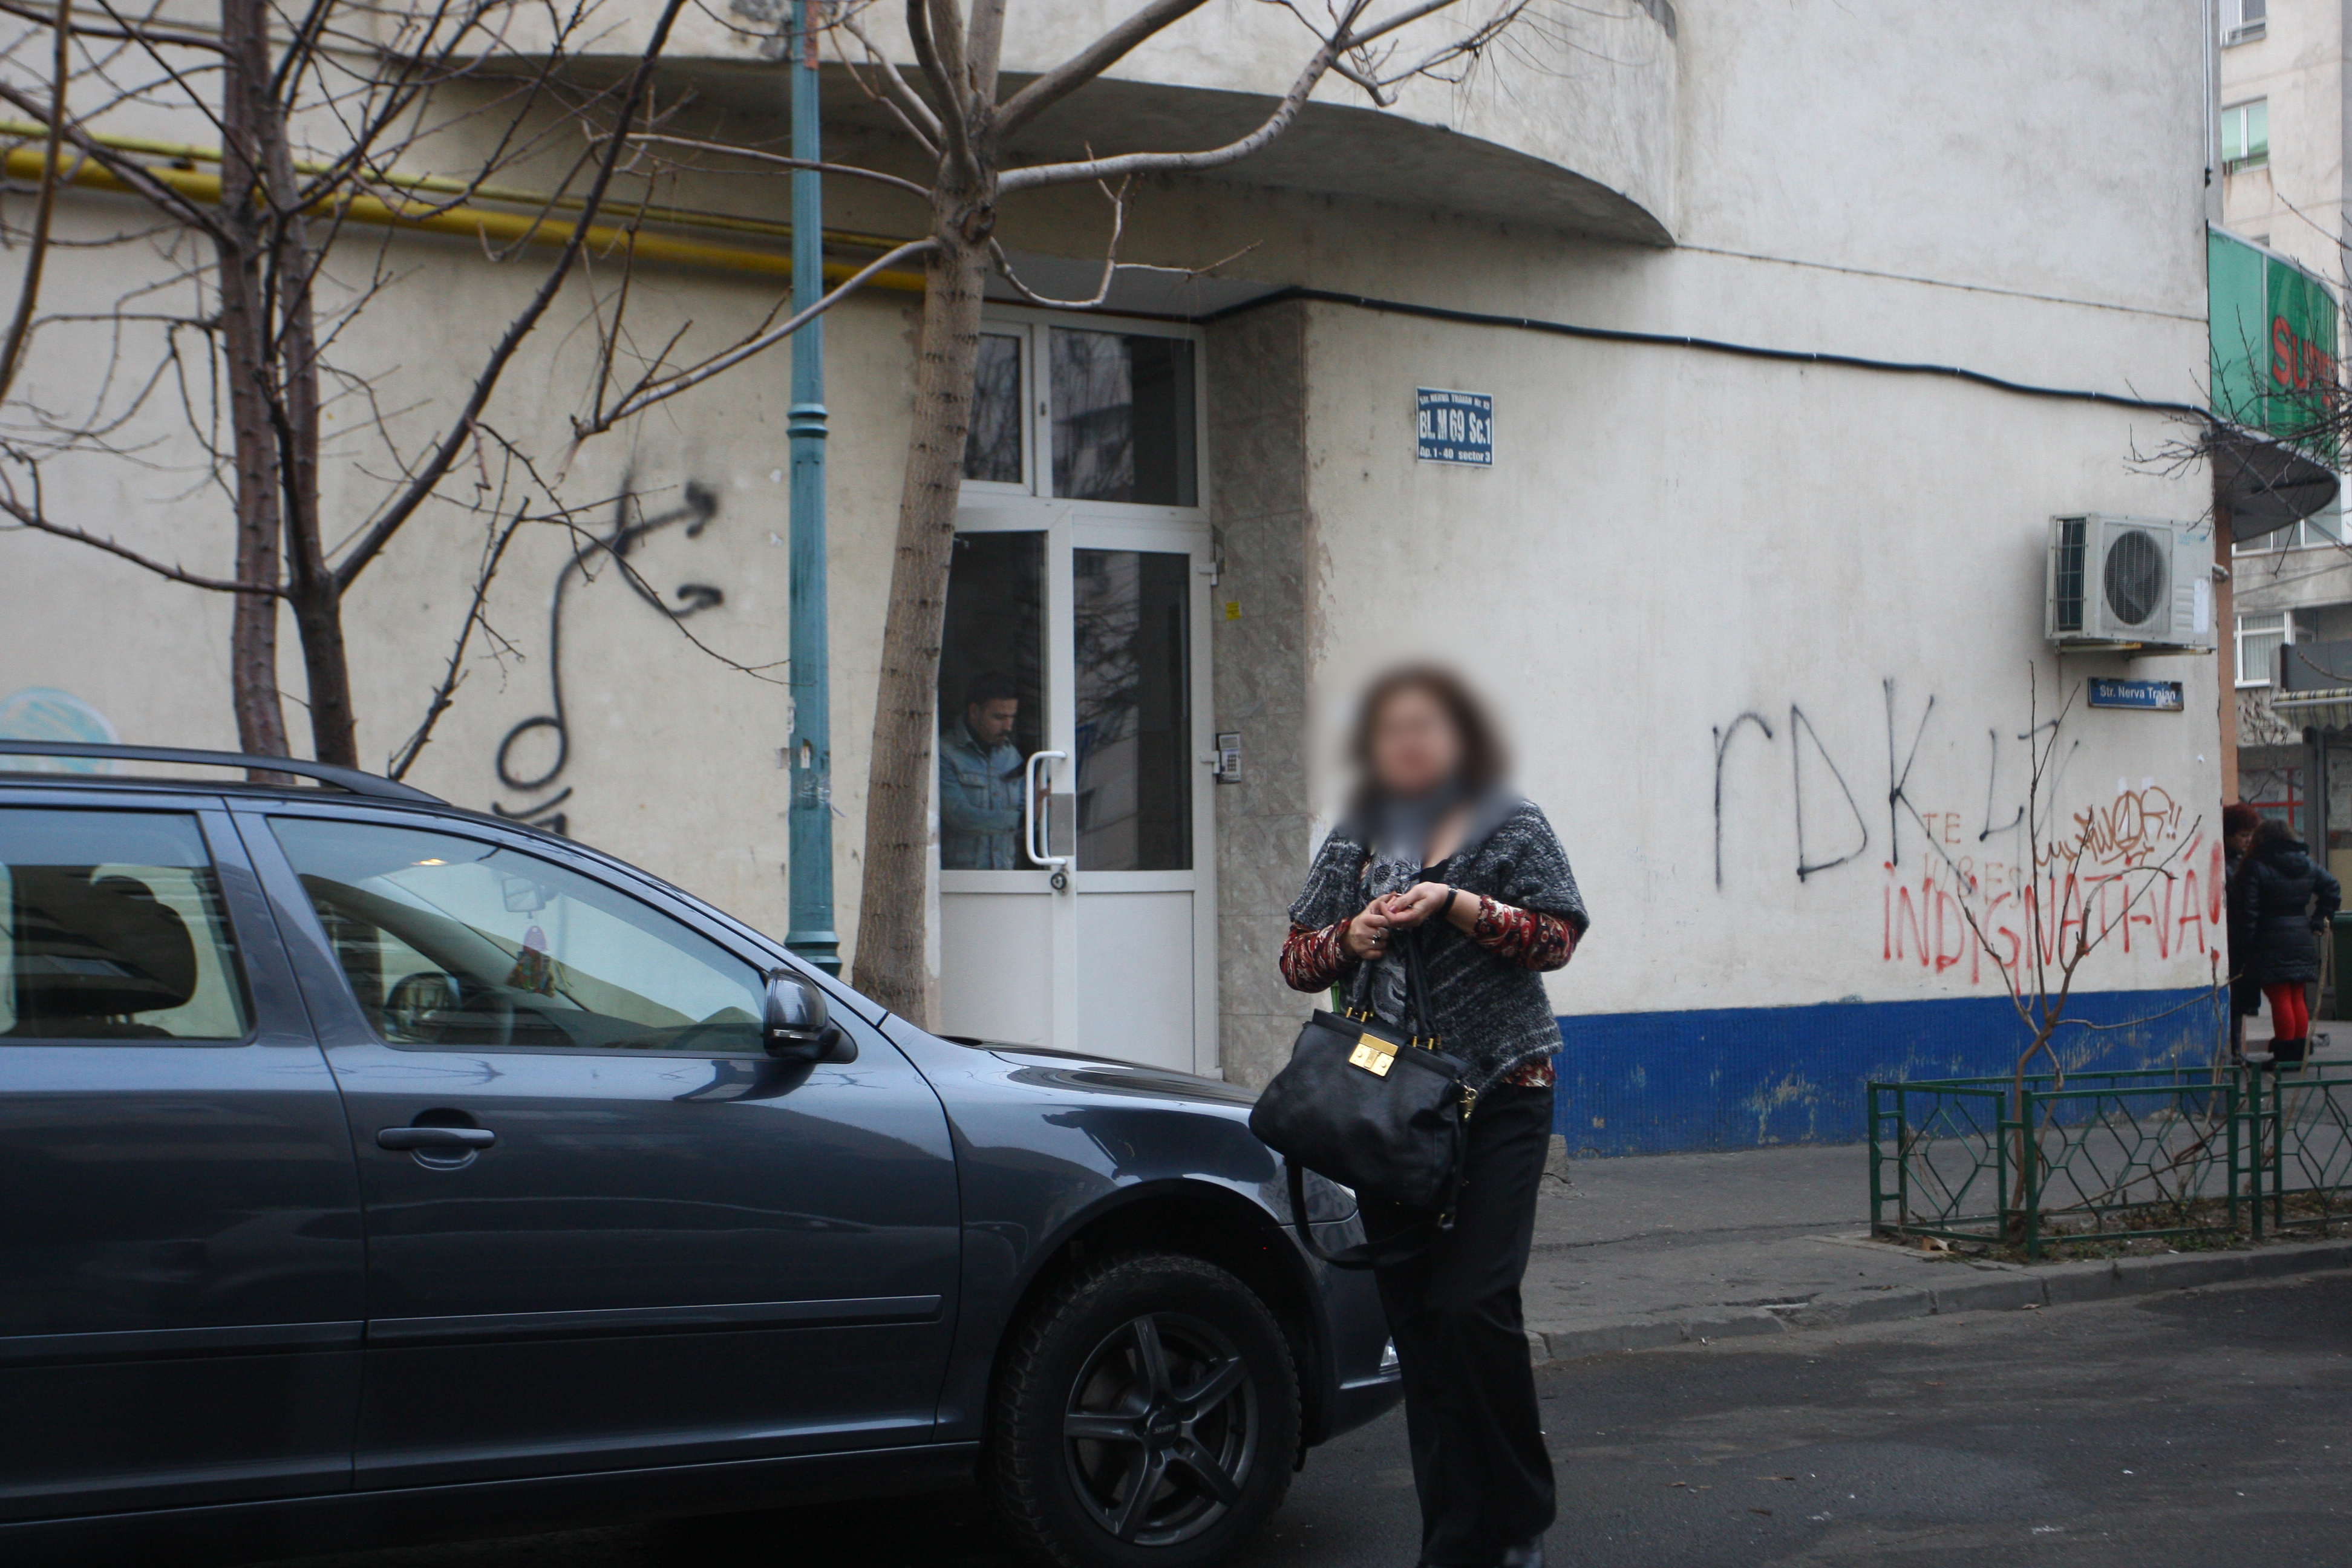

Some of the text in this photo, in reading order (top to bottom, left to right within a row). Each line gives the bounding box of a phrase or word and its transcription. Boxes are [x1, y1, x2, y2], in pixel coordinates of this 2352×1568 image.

[1459, 450, 1484, 462] sector
[1485, 452, 1491, 463] 3
[2100, 685, 2115, 697] Str.
[2118, 686, 2145, 699] Nerva
